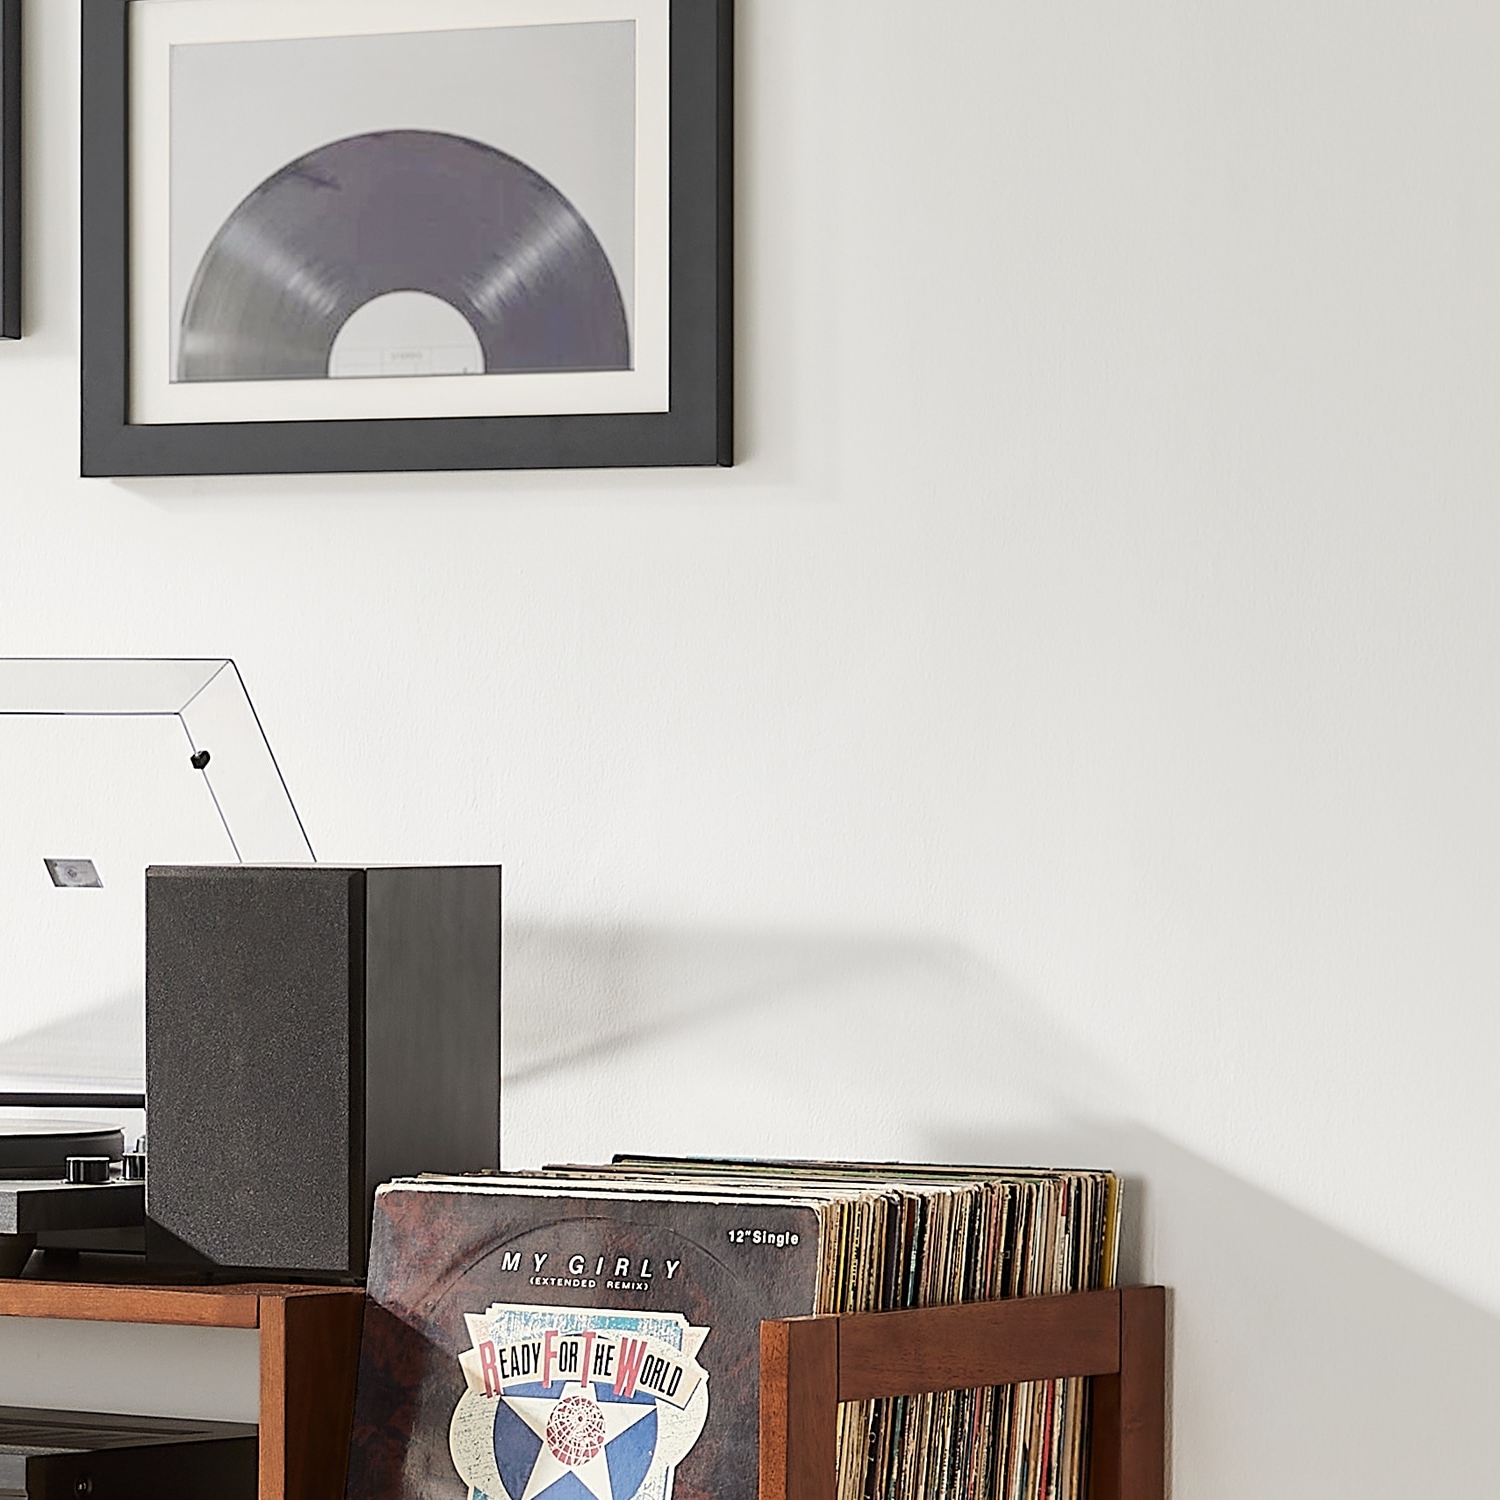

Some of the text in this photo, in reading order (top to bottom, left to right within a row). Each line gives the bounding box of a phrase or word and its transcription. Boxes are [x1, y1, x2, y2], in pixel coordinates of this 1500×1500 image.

[500, 1251, 681, 1280] MY GIRLY
[529, 1276, 649, 1292] (EXTENDED REMIX)
[479, 1330, 683, 1399] READY FOR THE WORLD
